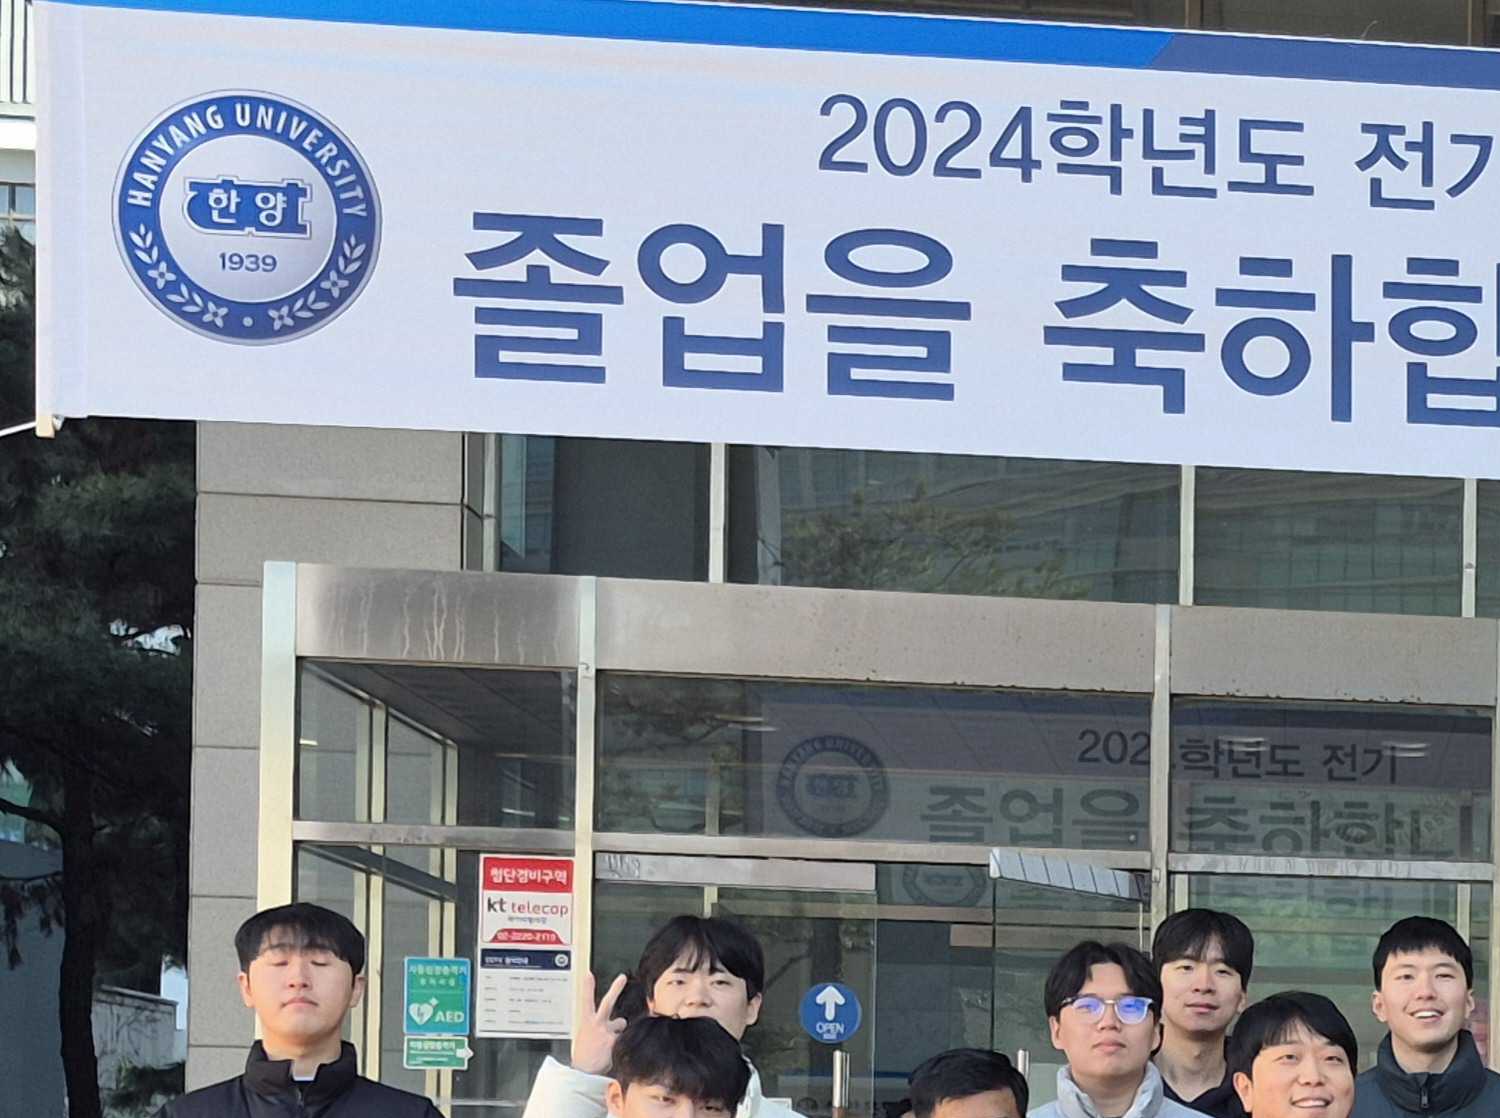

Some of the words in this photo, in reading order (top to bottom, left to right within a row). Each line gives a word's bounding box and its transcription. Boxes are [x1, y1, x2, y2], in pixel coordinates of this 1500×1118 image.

[127, 104, 225, 208] HANYANG
[235, 102, 368, 217] UNIVERSITY
[818, 93, 1315, 199] 2024학년도
[207, 188, 288, 226] 한양
[219, 252, 278, 273] 1939
[452, 210, 972, 402] 졸업을
[1321, 742, 1398, 784] 전기
[490, 866, 567, 885] 첨단경비구역
[487, 896, 507, 913] kt
[511, 900, 569, 917] telecop
[435, 1011, 465, 1023] AED
[816, 1022, 845, 1034] OPEN
